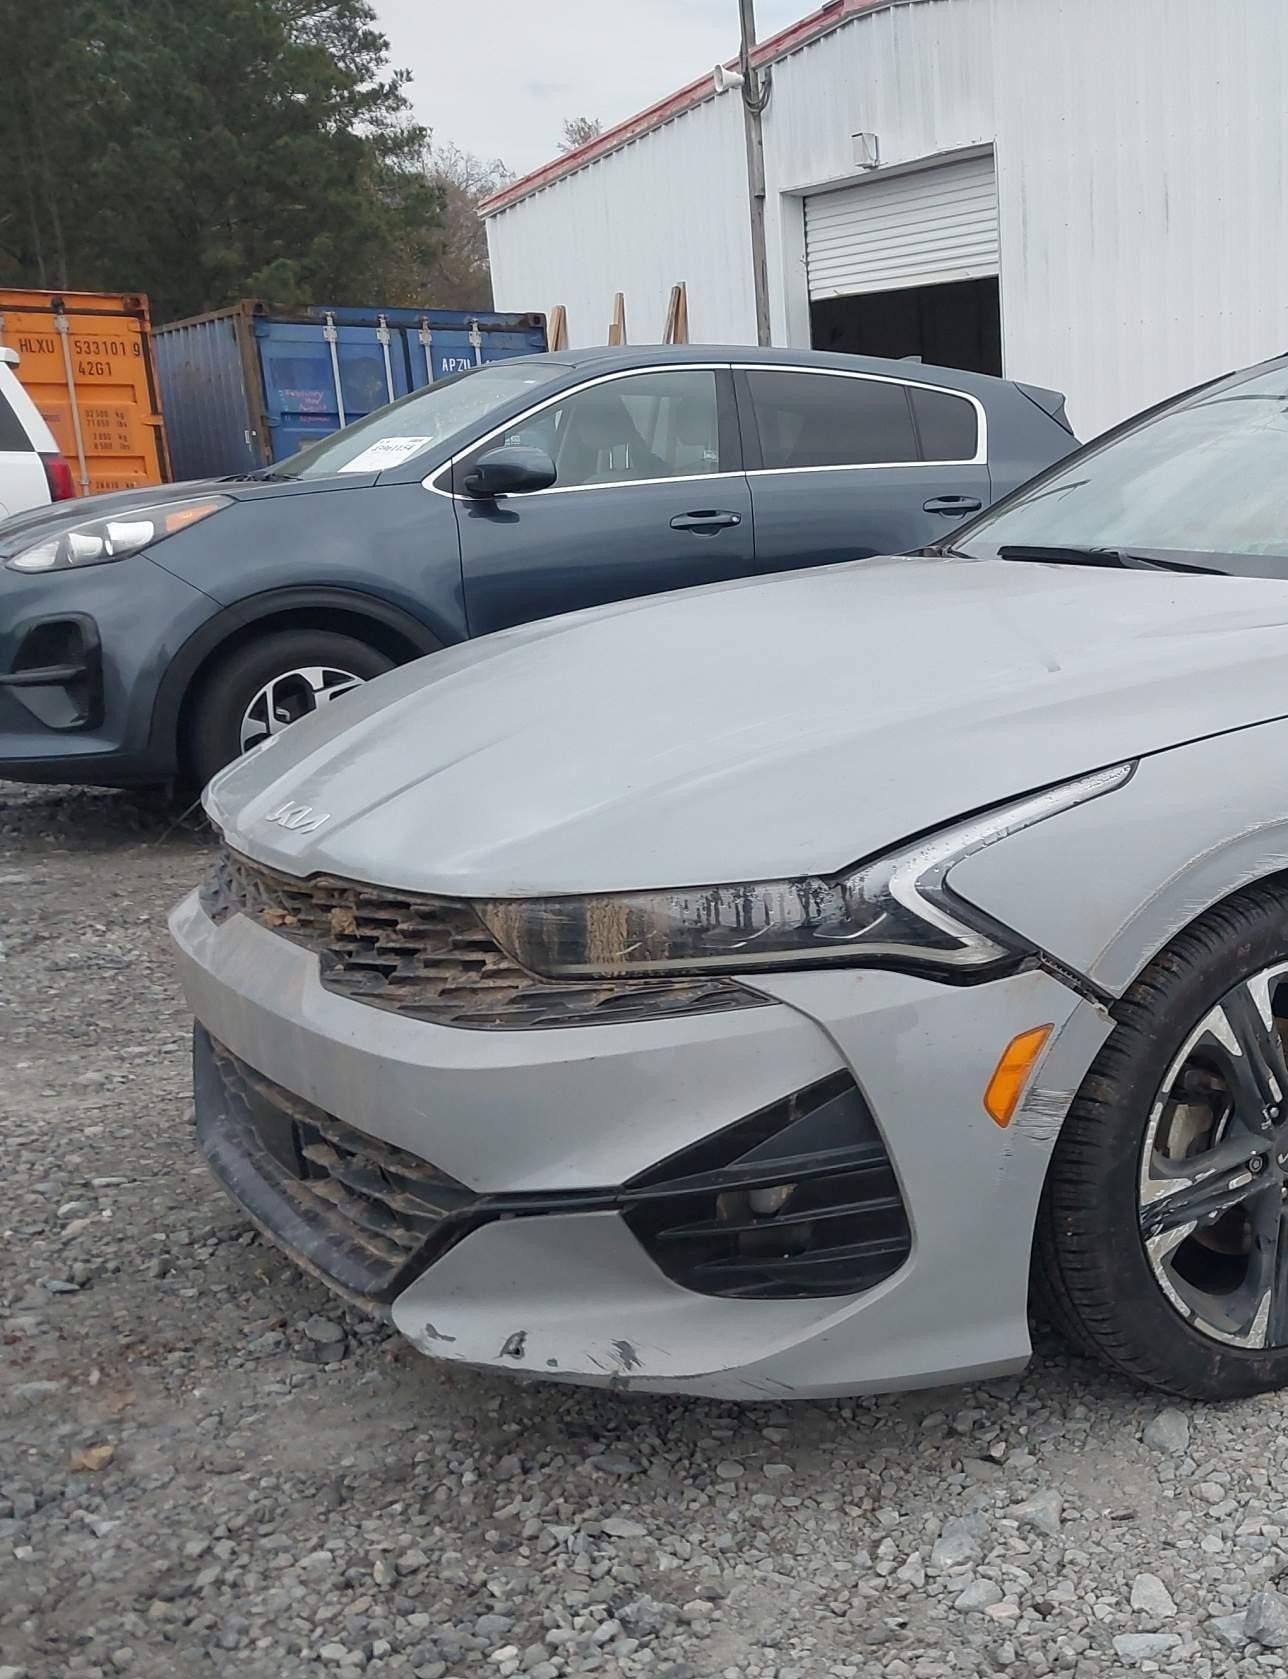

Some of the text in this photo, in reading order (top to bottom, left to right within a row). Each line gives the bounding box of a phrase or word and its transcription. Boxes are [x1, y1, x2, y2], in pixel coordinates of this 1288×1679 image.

[20, 339, 140, 357] HLXU 533101 9
[78, 361, 112, 376] 42G1
